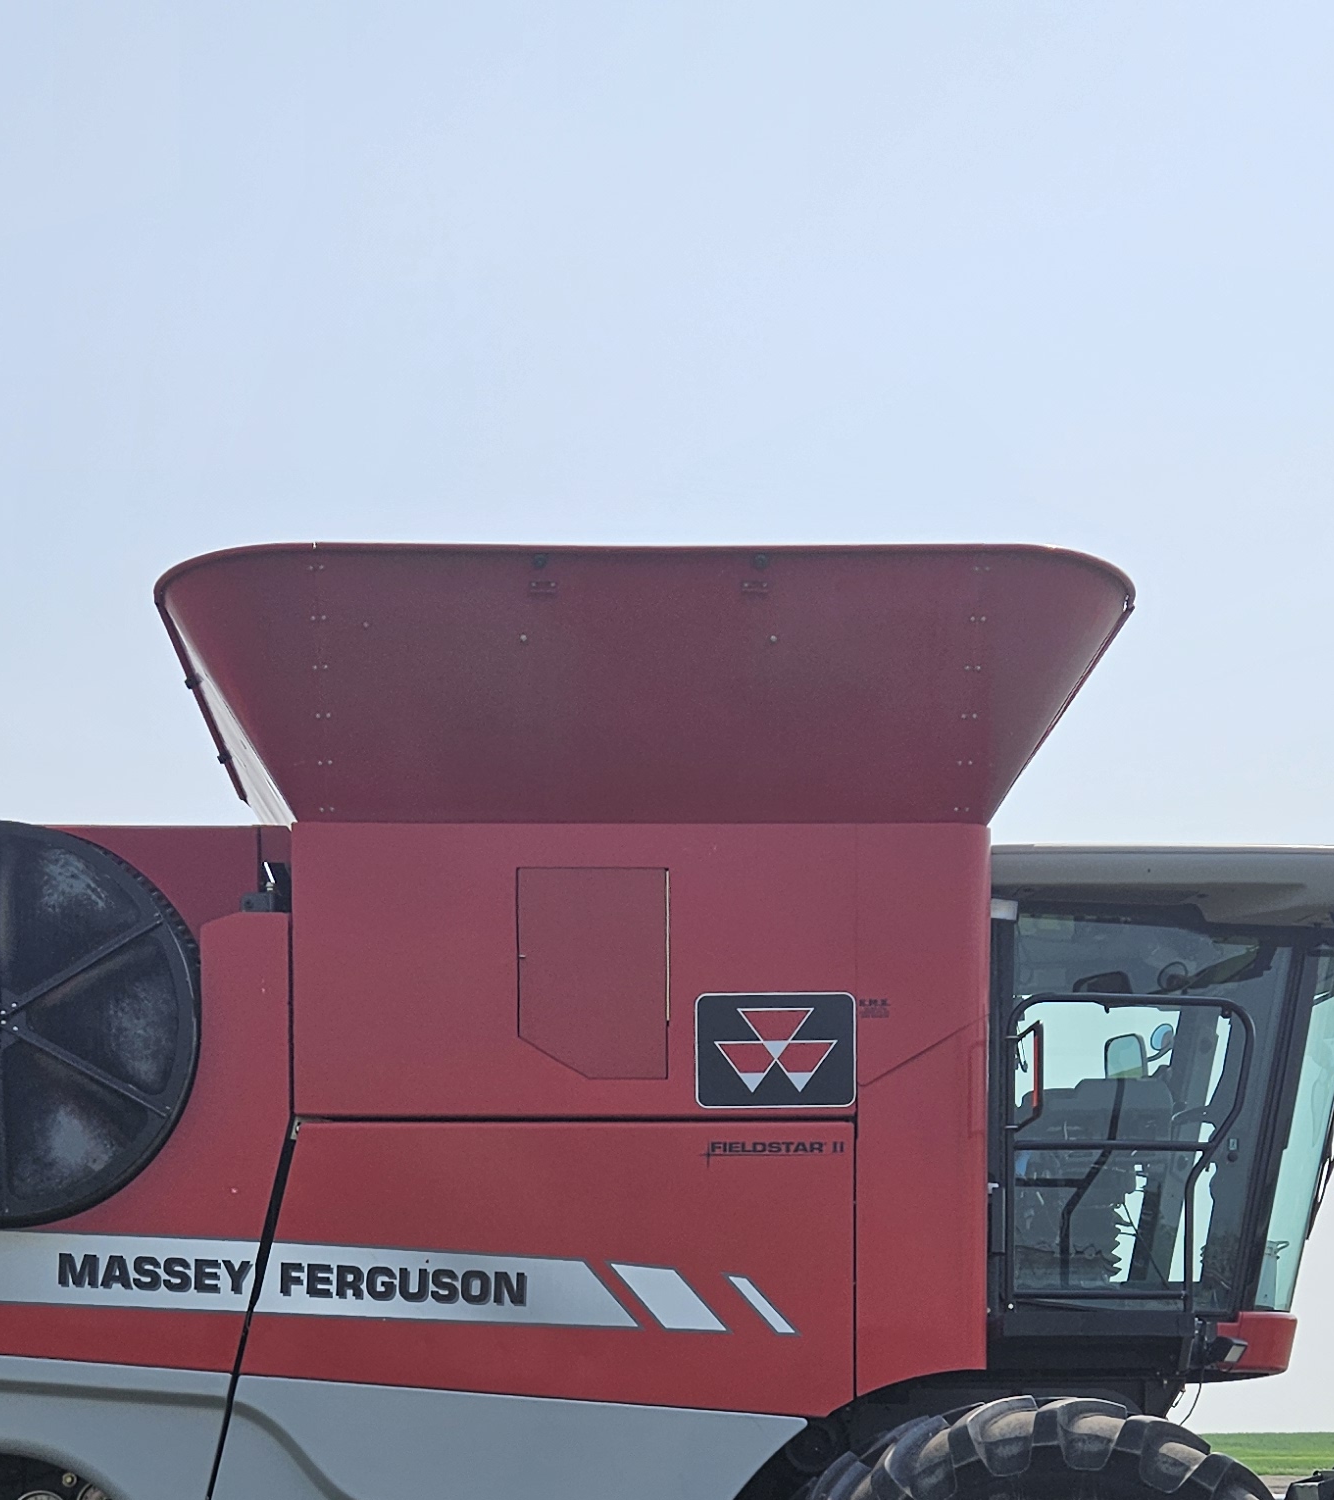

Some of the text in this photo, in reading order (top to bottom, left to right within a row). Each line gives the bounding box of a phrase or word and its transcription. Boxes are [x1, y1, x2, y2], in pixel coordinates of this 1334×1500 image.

[710, 1141, 844, 1153] FIELDSTAR II
[58, 1252, 527, 1306] MASSEY FERGUSON
